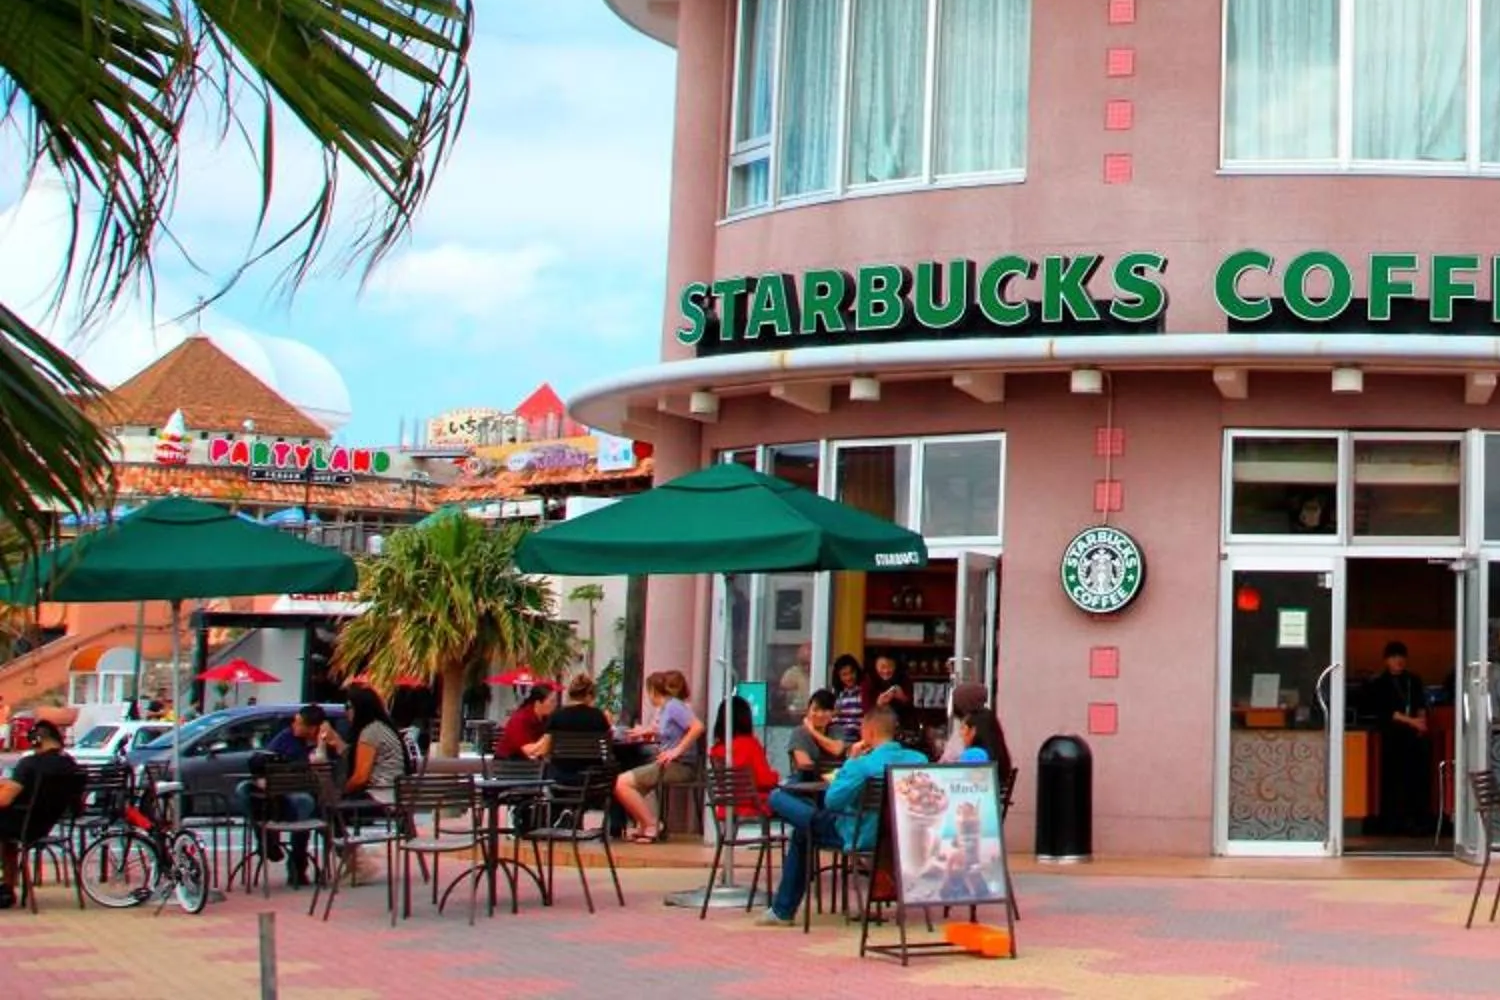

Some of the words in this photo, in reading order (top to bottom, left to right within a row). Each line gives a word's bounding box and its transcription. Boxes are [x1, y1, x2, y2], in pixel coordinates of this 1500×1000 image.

[676, 251, 1168, 346] STARBUCKS
[210, 437, 391, 473] PARTYLAND
[1067, 531, 1138, 569] STARBUCKS
[1073, 586, 1129, 608] COFFEE
